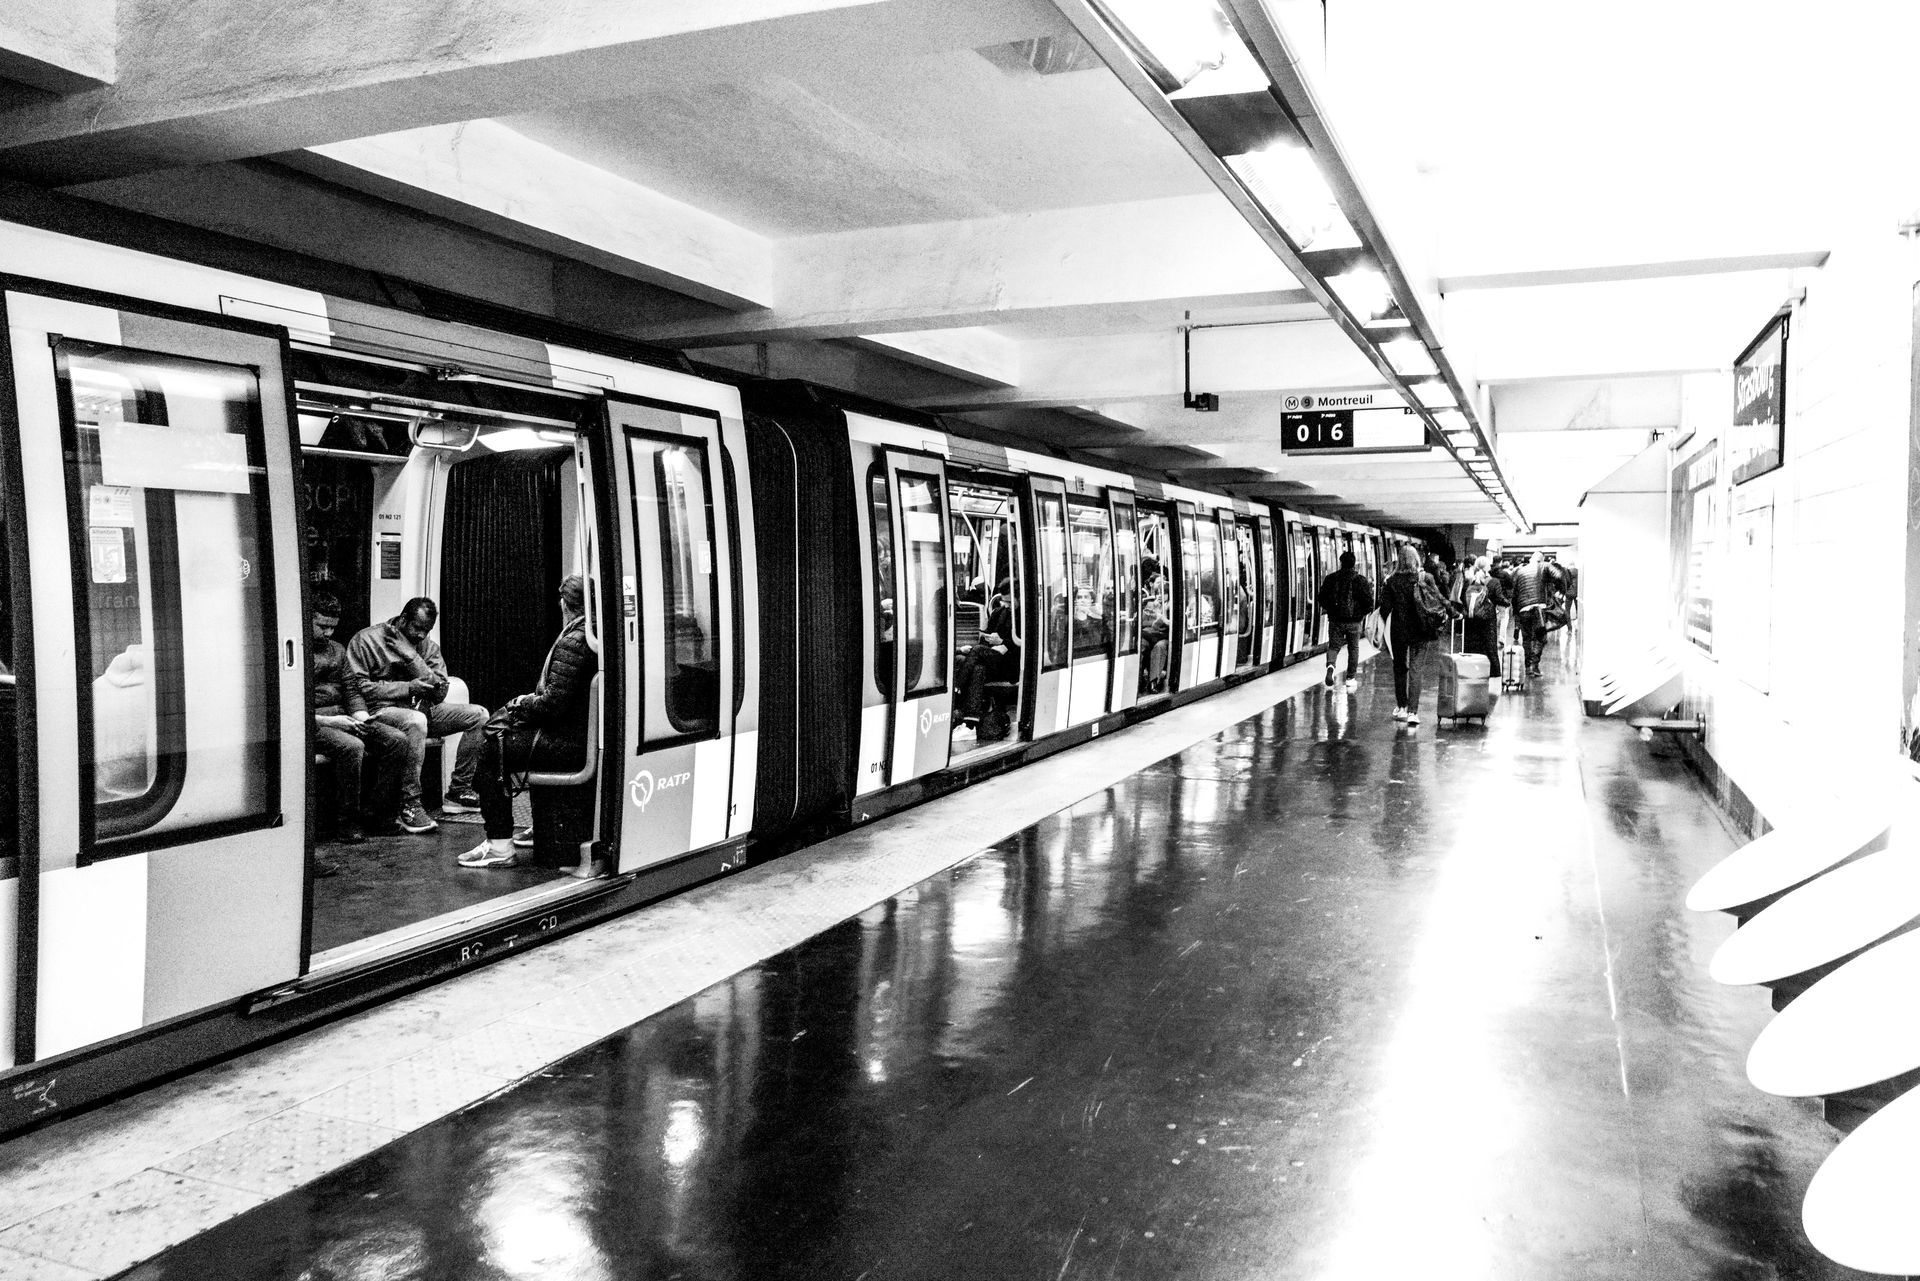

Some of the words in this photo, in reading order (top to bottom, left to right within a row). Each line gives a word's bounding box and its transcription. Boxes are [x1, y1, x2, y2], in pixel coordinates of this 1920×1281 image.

[1736, 353, 1775, 413] Strasbourg
[1304, 398, 1311, 407] 9
[1318, 395, 1373, 407] Montreuil
[1297, 424, 1310, 442] 0
[1331, 423, 1344, 441] 6
[932, 712, 950, 724] RATP
[870, 762, 878, 774] 01
[657, 772, 691, 791] RATP
